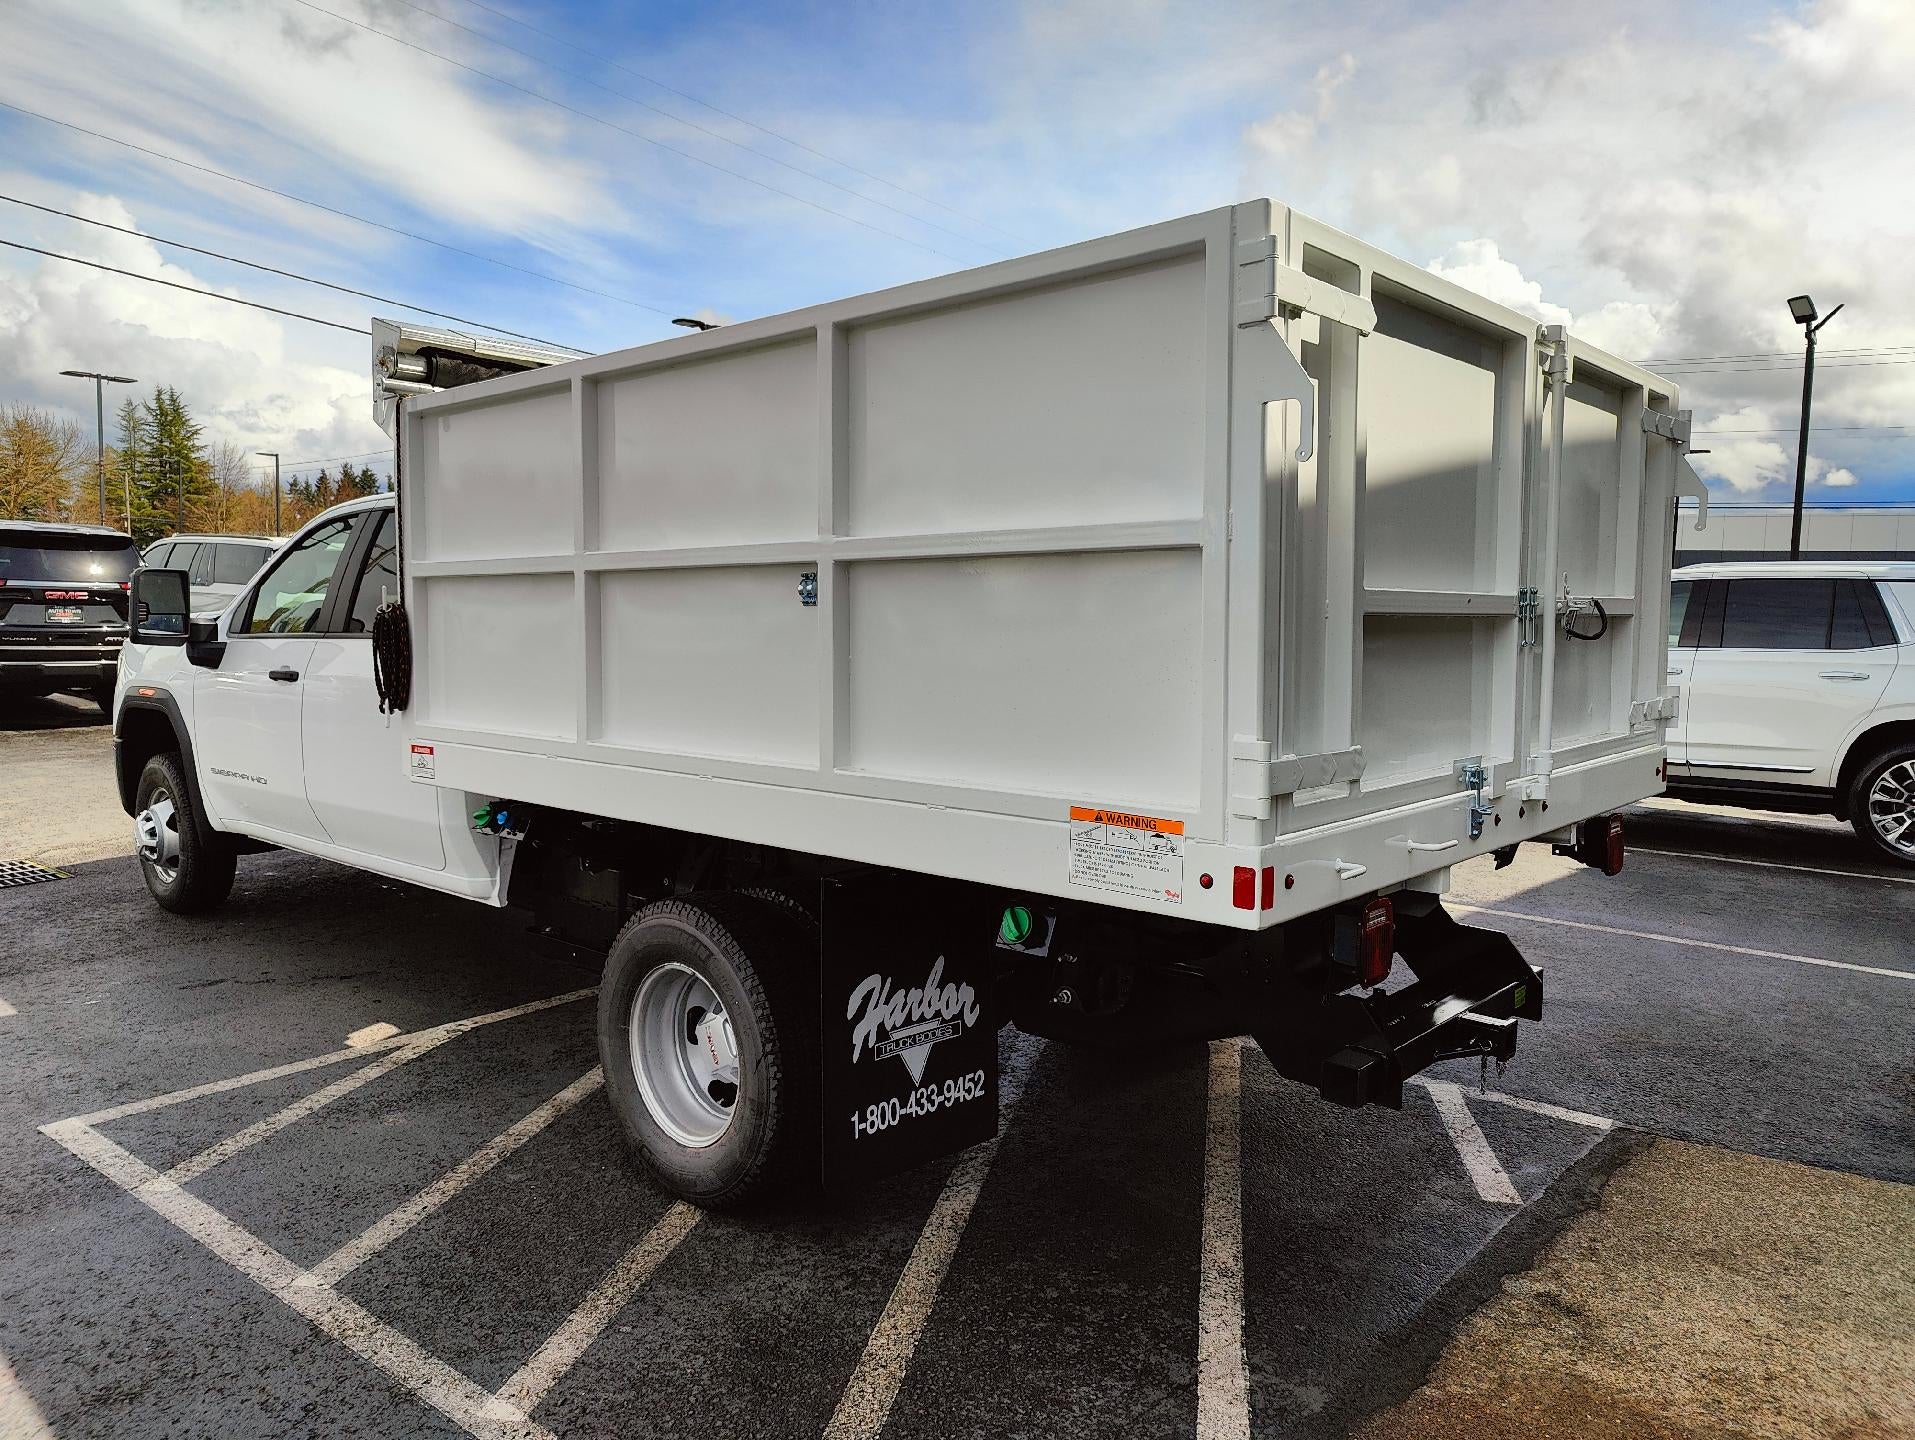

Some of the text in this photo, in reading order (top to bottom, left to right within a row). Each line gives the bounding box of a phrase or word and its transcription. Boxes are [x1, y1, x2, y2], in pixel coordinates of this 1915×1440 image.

[45, 591, 89, 600] GMC
[1105, 812, 1157, 831] WARNING
[847, 955, 980, 1064] Harbor
[880, 1025, 953, 1054] TRUCK BODIES
[850, 1069, 985, 1140] 1-800-433-9452
